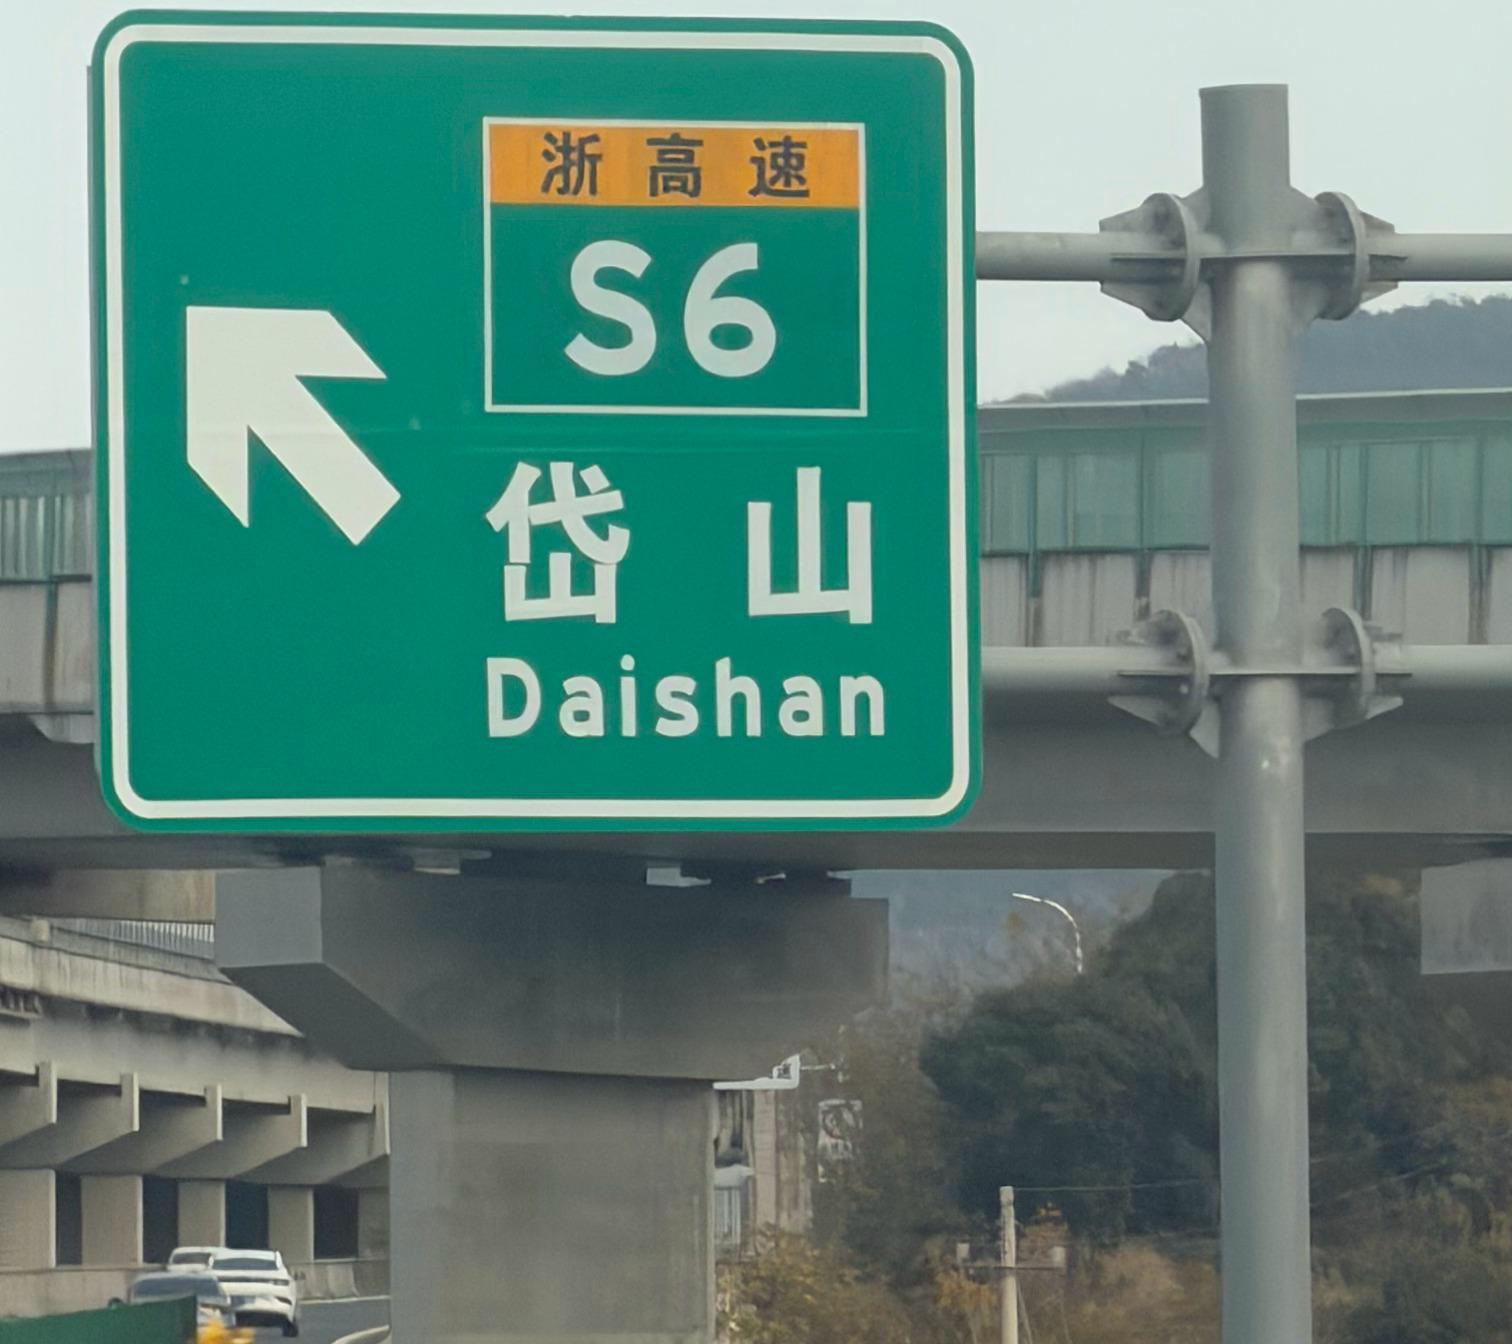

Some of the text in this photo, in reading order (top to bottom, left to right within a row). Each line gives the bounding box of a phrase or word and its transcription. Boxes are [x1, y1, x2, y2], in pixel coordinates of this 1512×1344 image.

[541, 131, 810, 198] 浙高速
[564, 239, 777, 378] S6
[485, 461, 873, 625] 岱山
[486, 654, 886, 738] Daishan
